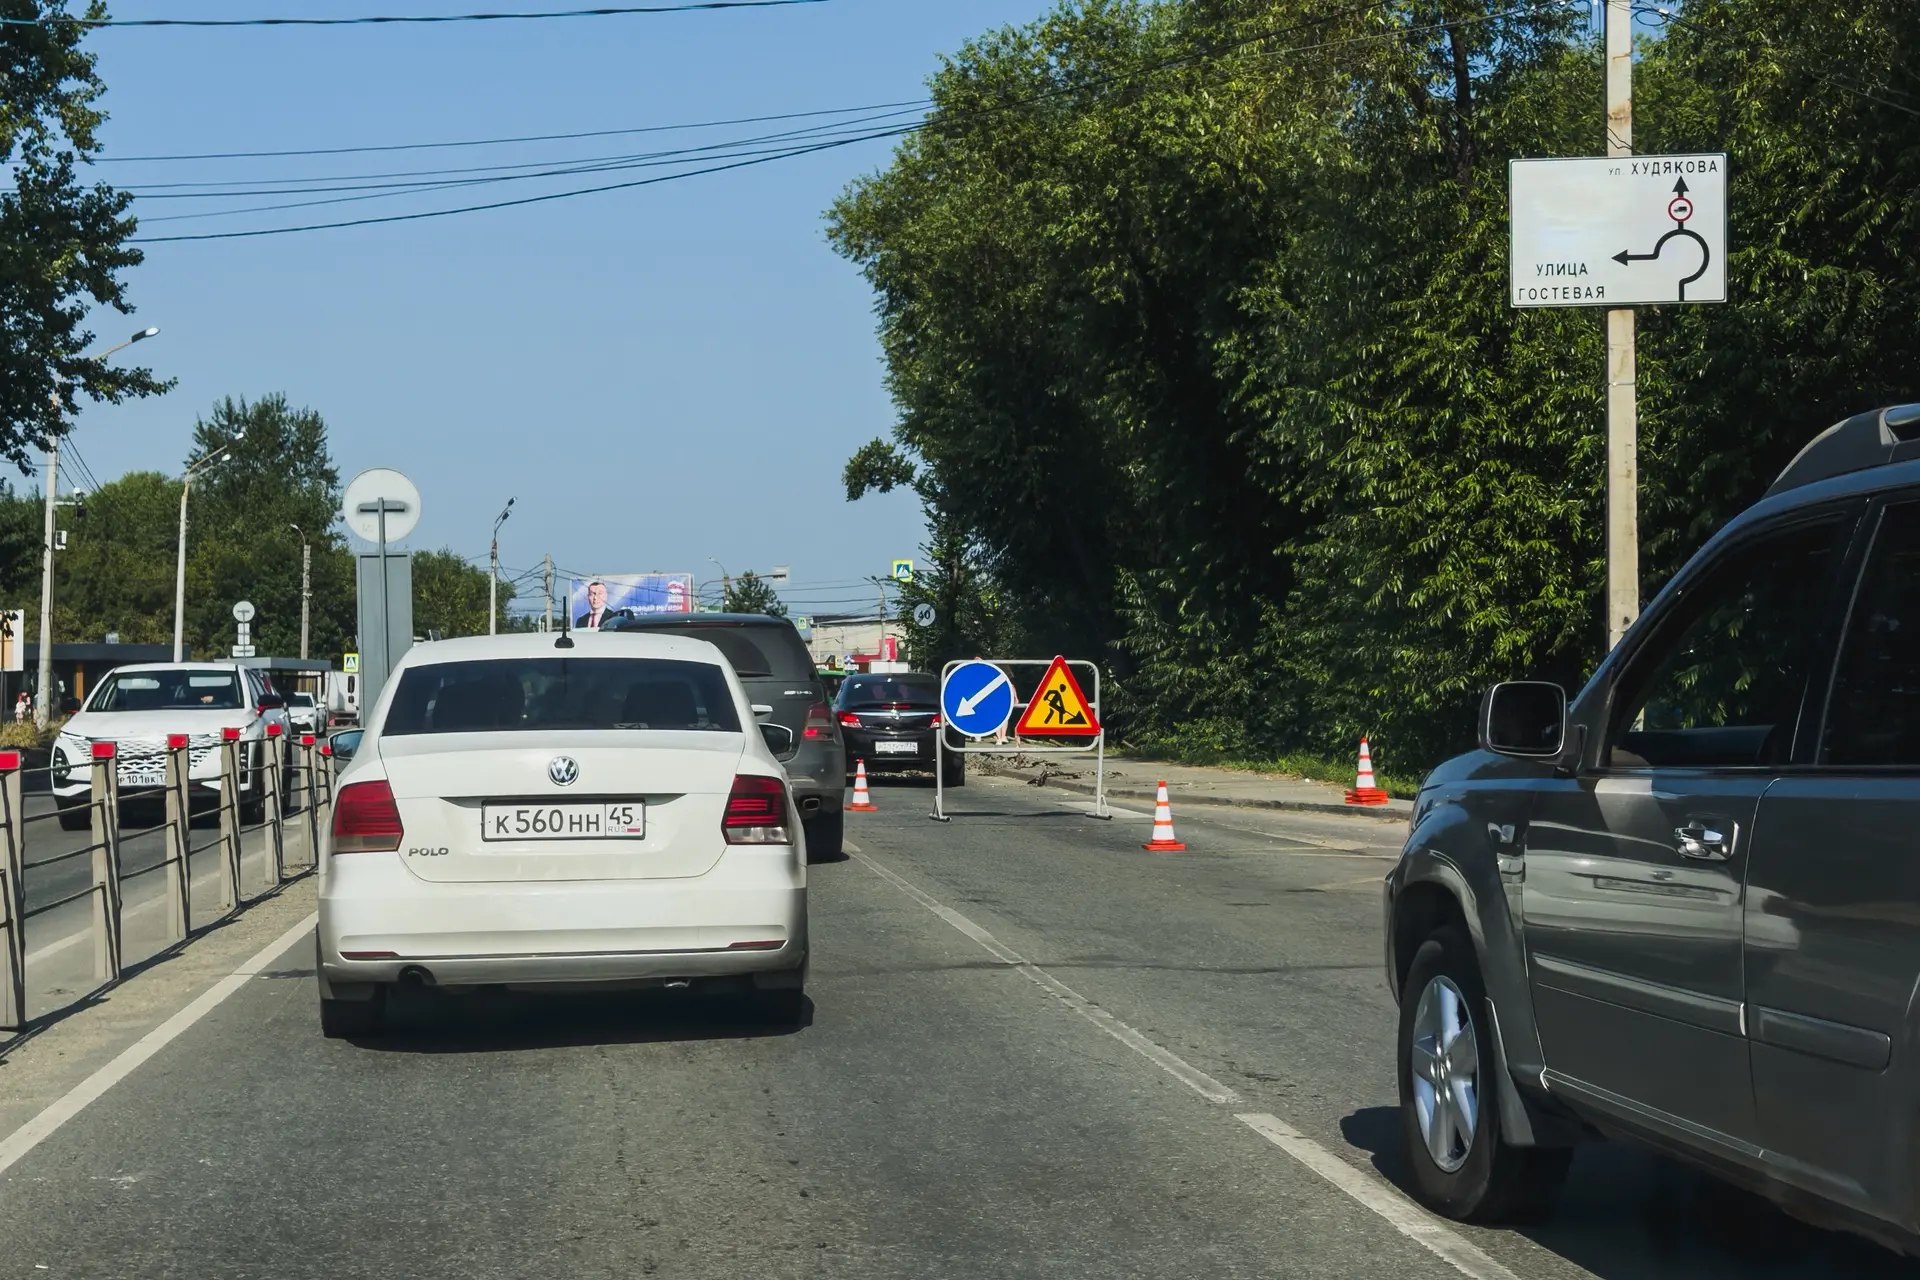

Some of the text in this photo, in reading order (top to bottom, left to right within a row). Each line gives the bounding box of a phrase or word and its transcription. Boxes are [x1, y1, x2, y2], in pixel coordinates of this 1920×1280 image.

[1631, 160, 1718, 176] ХУДЯКОВА
[1536, 263, 1588, 277] УЛИЦА
[1518, 286, 1605, 300] ГОСТЕВАЯ
[918, 611, 930, 620] 40
[609, 807, 634, 825] 45
[408, 847, 449, 857] POLO
